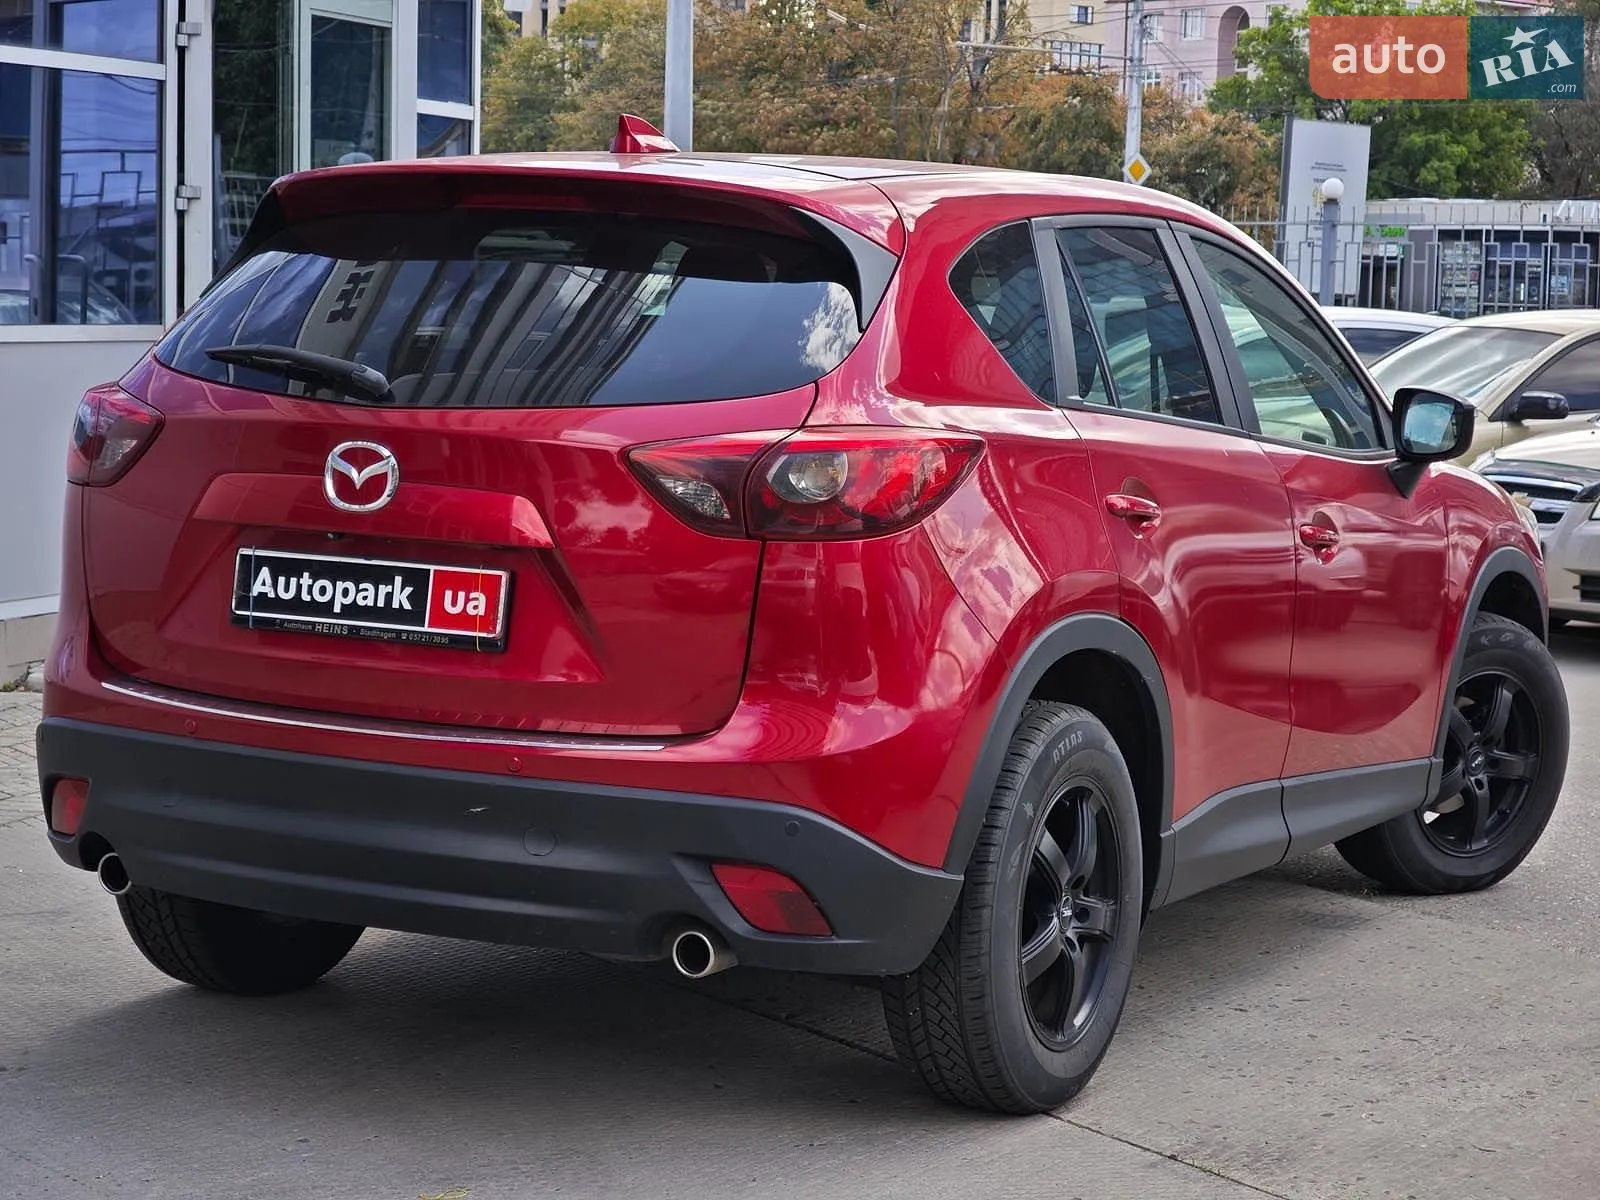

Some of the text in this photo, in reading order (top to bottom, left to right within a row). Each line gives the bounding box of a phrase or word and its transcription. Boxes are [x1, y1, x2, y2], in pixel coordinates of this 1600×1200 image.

[252, 566, 487, 616] Autopark ua
[314, 623, 349, 635] HEINS
[1053, 730, 1083, 764] ATLAS
